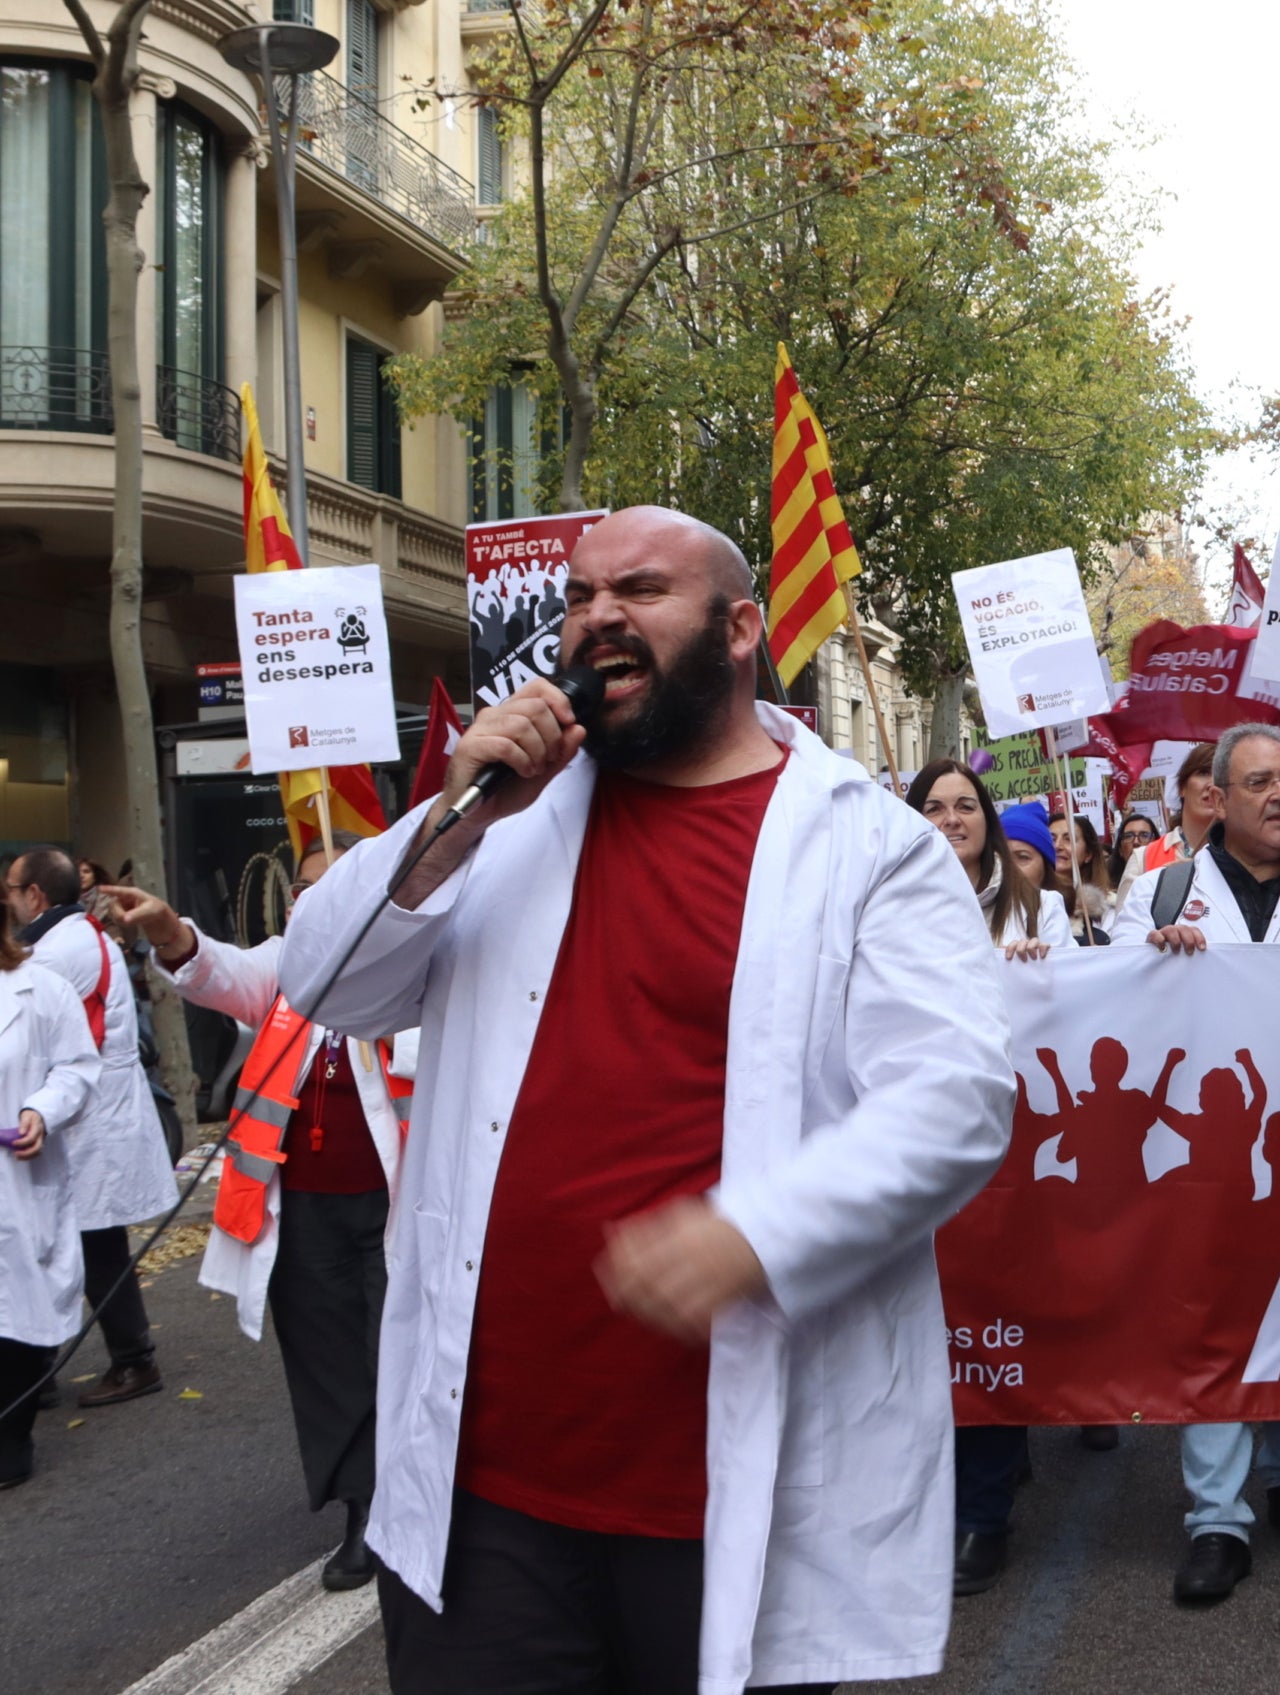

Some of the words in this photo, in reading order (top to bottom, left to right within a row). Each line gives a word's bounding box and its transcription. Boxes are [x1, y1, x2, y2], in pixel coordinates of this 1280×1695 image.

[473, 536, 480, 544] A
[482, 533, 494, 542] TU
[496, 529, 525, 540] TAMBÉ
[473, 538, 565, 562] T'AFECTA
[971, 597, 992, 610] NO
[996, 590, 1015, 604] ÉS
[252, 609, 313, 627] Tanta
[975, 600, 1044, 624] VOCACIÓ,
[254, 627, 330, 646] espera
[978, 624, 997, 638] ÉS
[981, 620, 1077, 652] EXPLOTACIÓ!
[256, 649, 296, 664] ens
[258, 661, 374, 683] desespera
[200, 685, 221, 697] H10
[246, 818, 274, 827] COCO
[982, 1318, 1024, 1348] de
